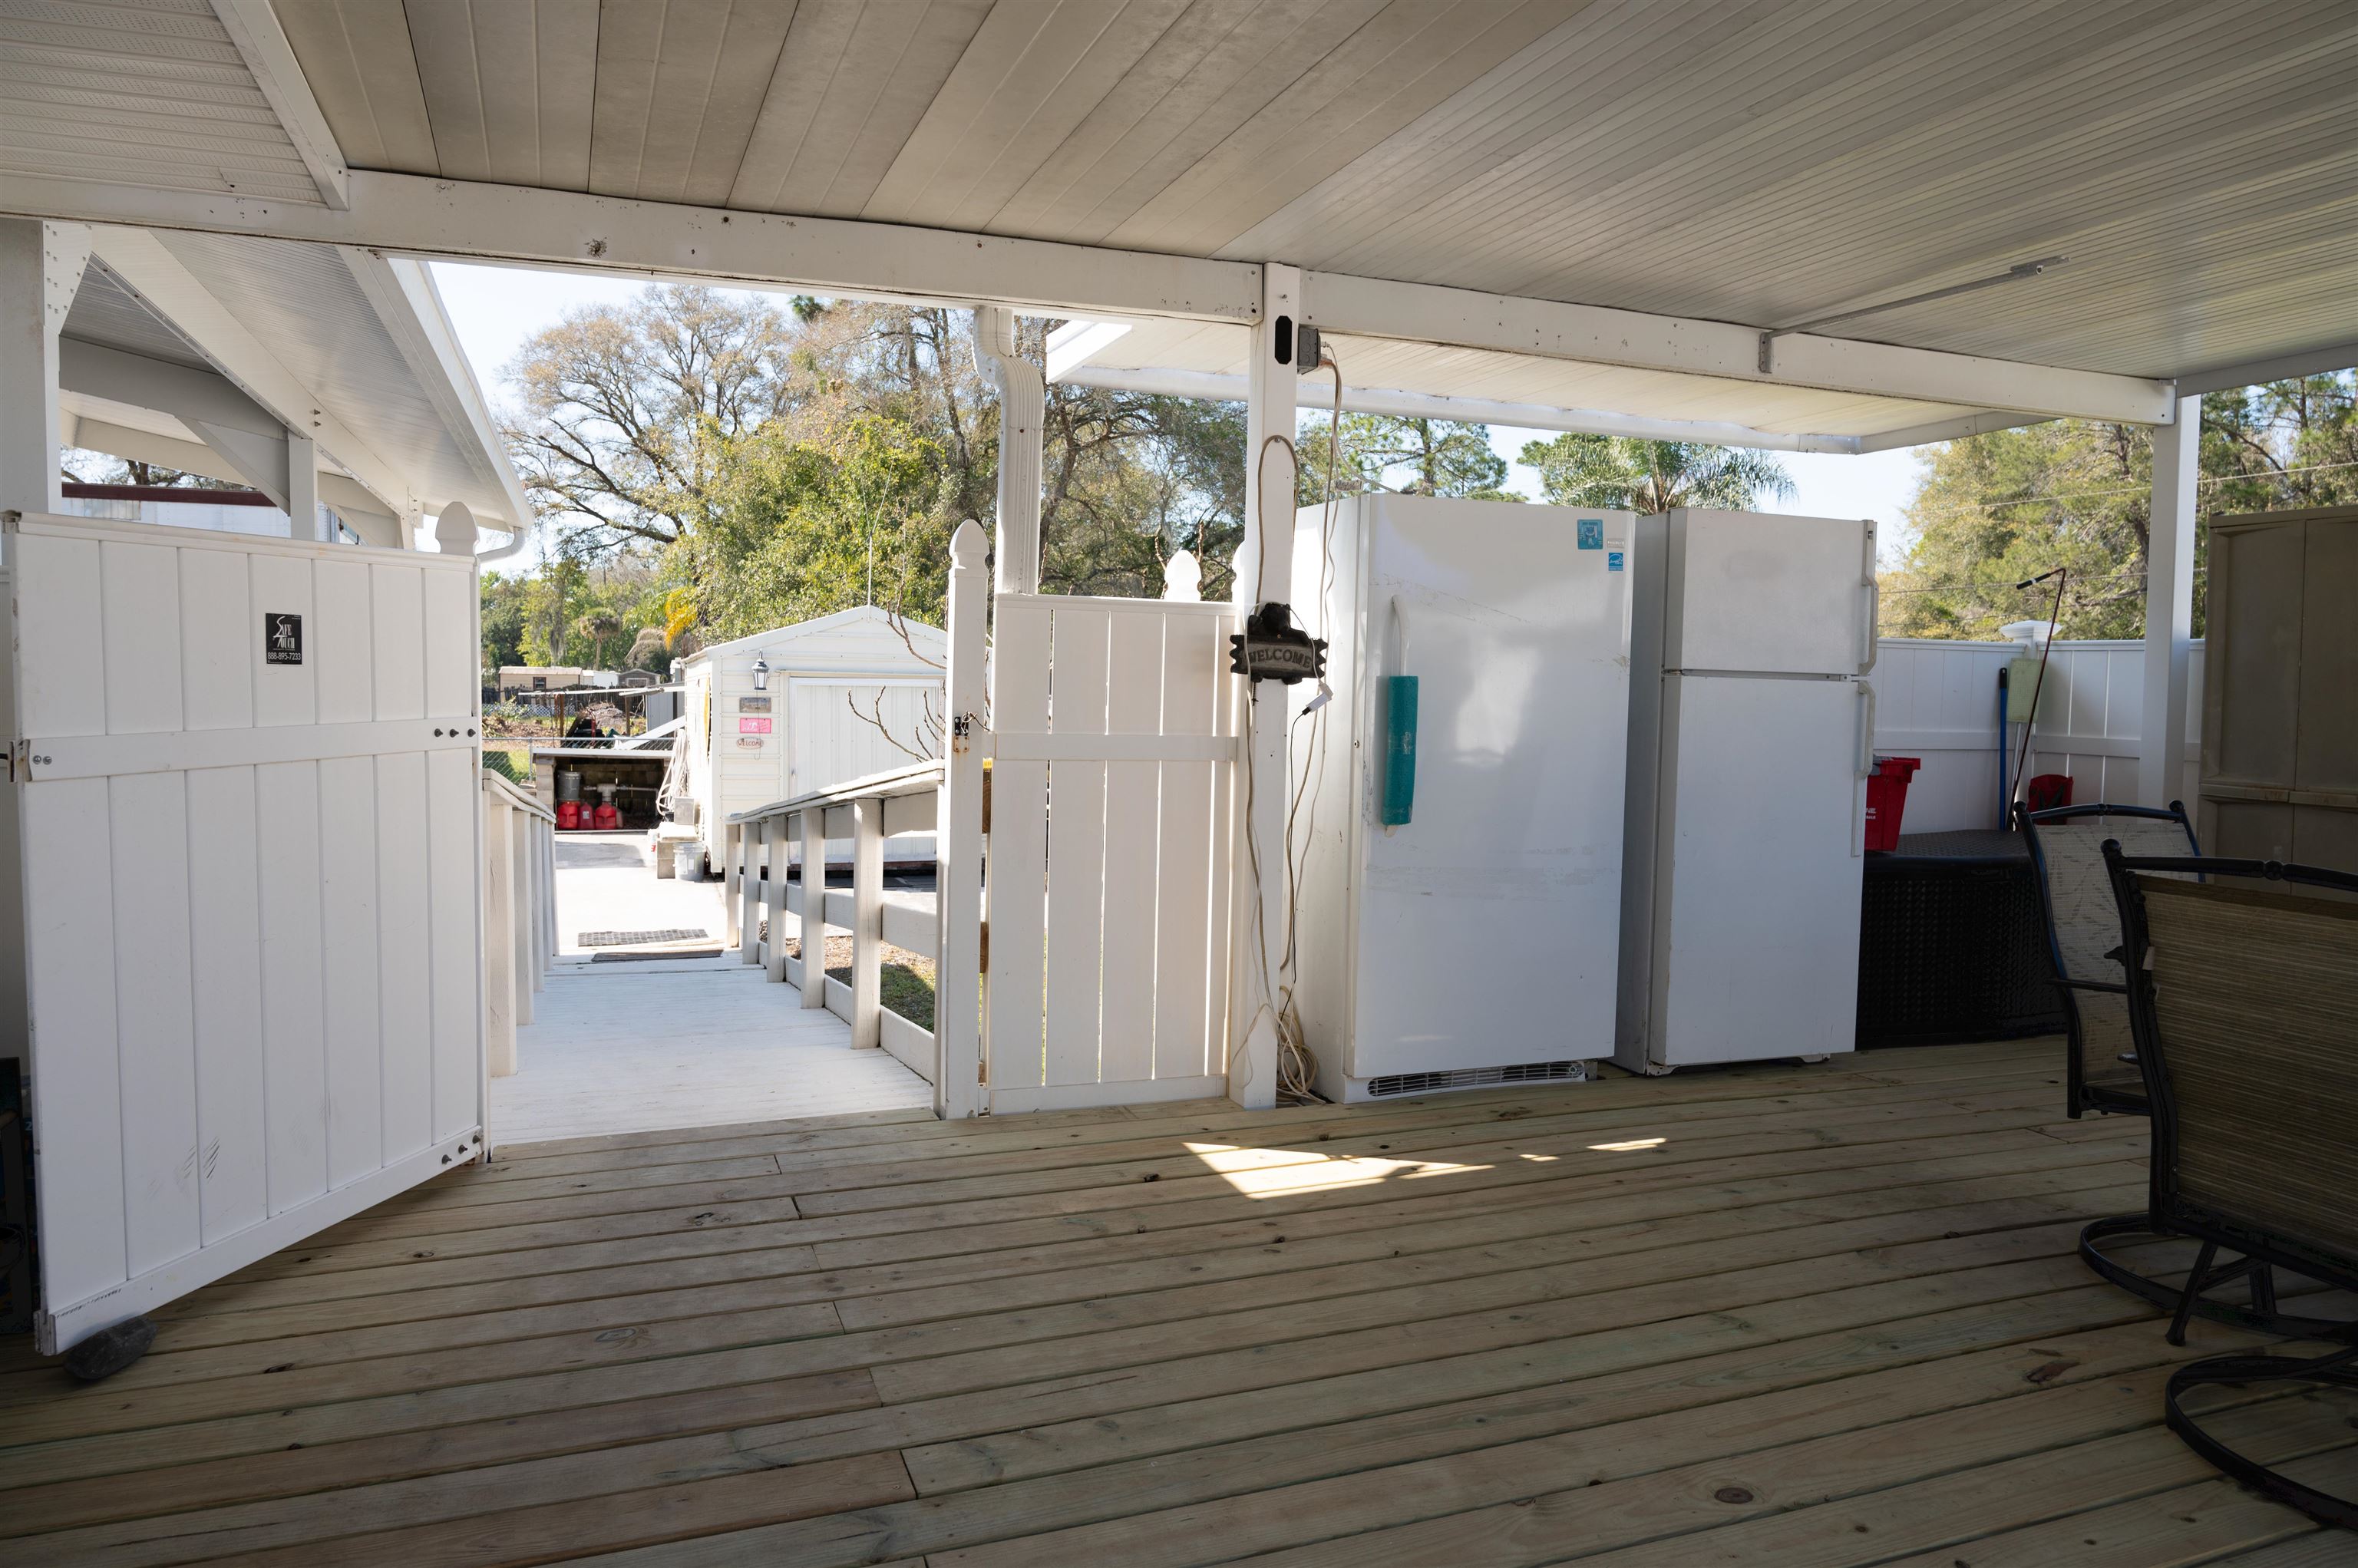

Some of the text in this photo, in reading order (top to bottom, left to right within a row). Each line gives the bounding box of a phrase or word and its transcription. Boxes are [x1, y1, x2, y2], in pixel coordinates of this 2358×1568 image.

[276, 616, 292, 635] SAFE
[273, 635, 295, 649] TOUCH
[268, 652, 302, 661] 888-895-7233
[1248, 649, 1312, 668] WELCOME
